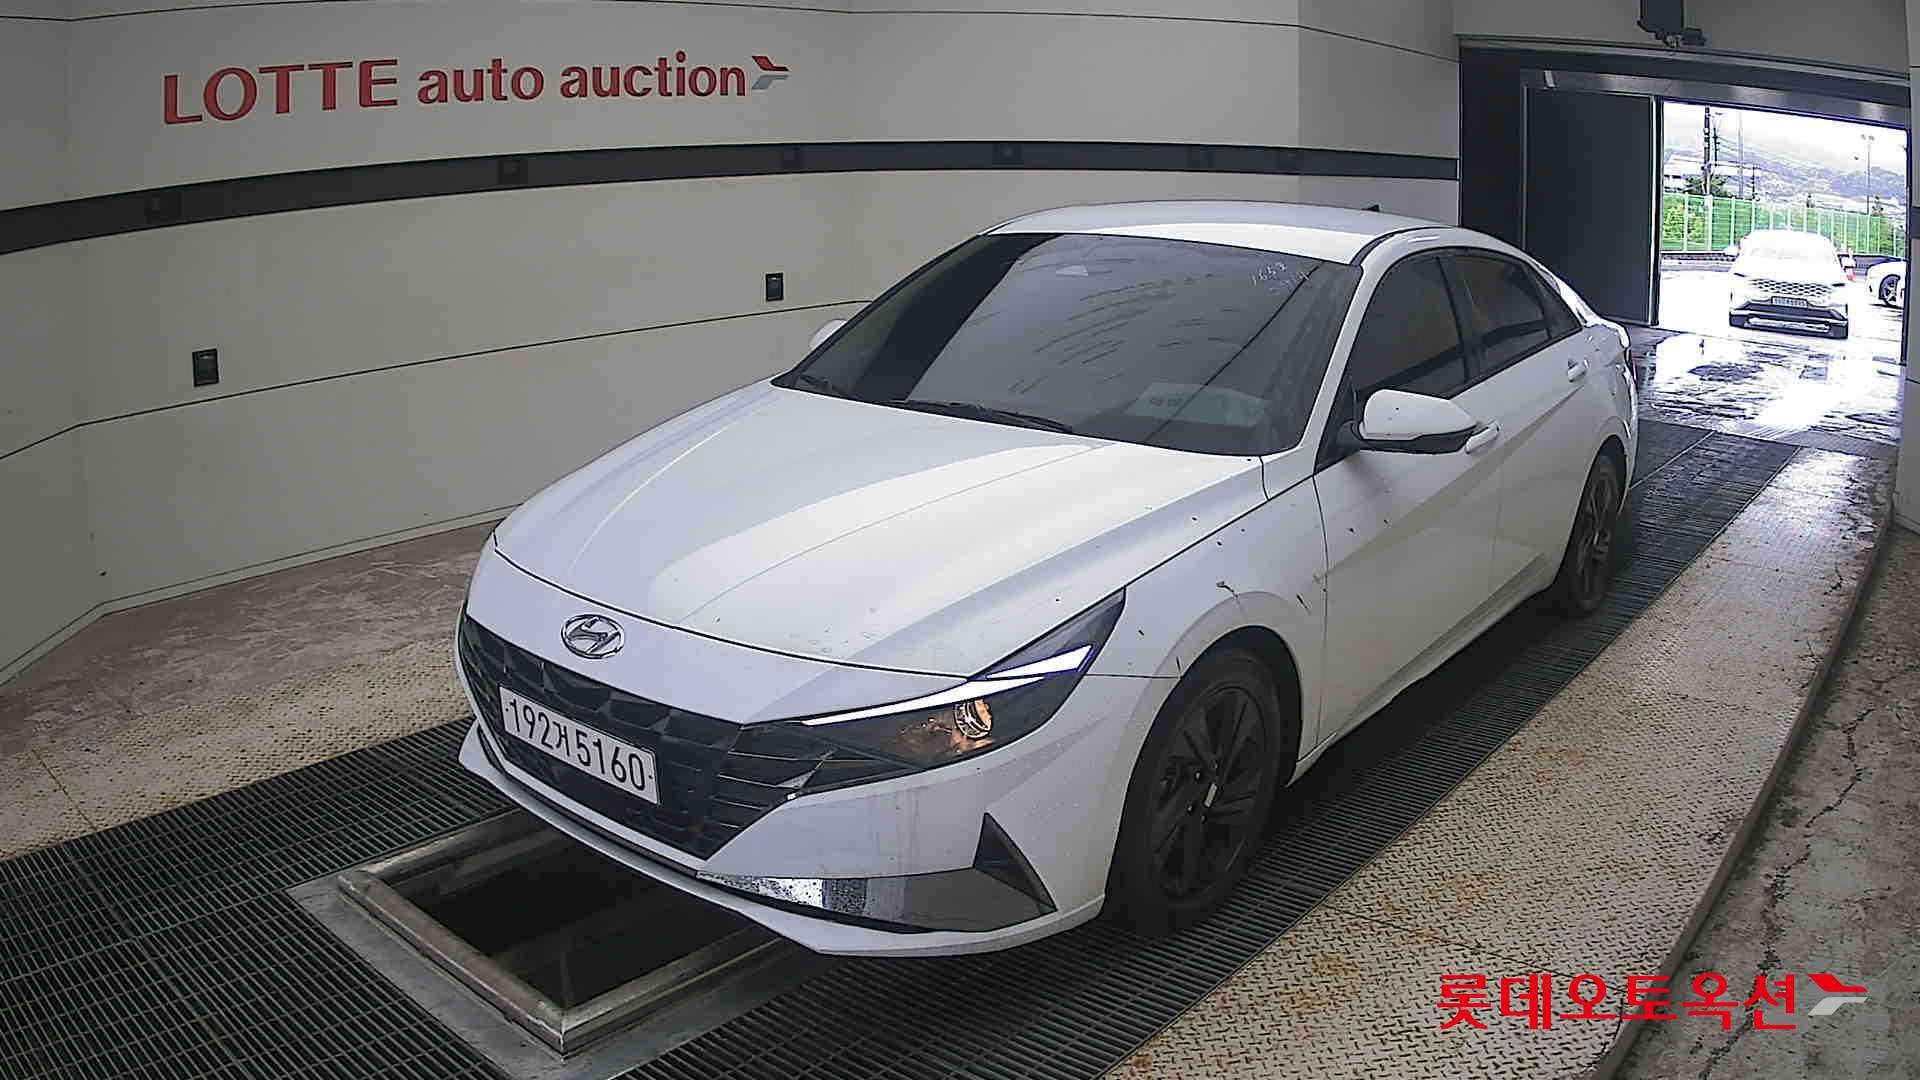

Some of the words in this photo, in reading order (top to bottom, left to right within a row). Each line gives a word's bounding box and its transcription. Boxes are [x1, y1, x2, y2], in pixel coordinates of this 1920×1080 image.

[163, 58, 398, 125] LOTTE
[416, 58, 545, 104] auto
[559, 51, 748, 98] auction
